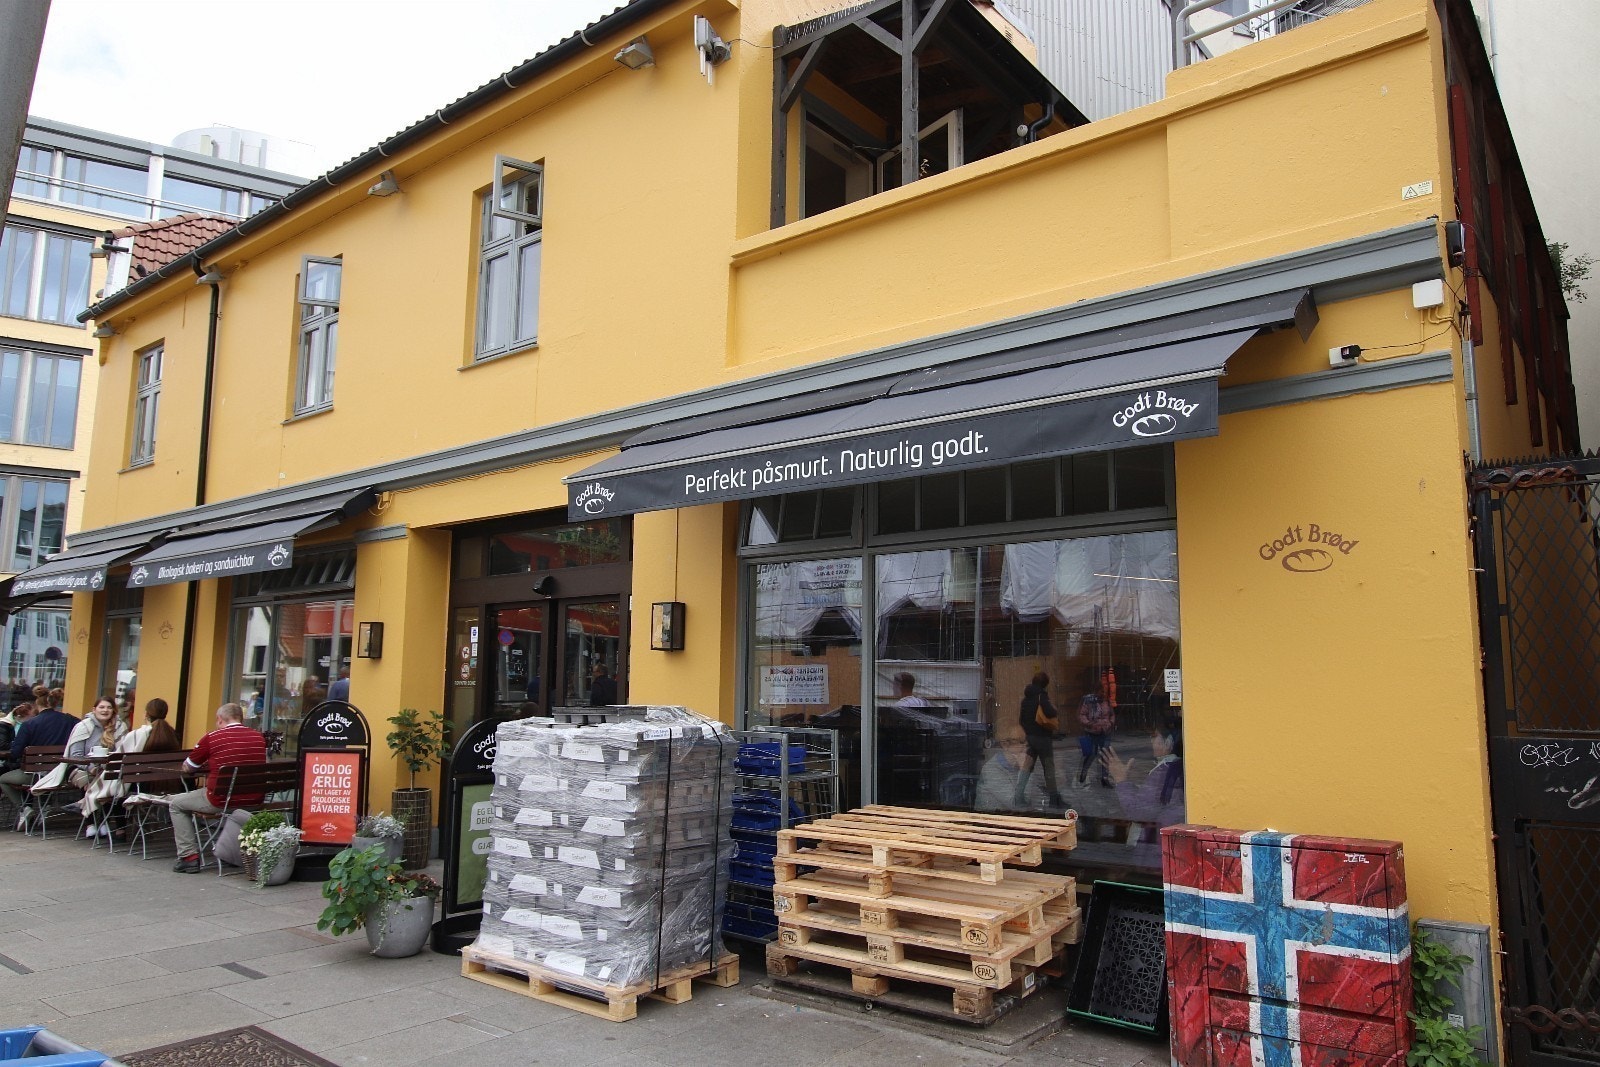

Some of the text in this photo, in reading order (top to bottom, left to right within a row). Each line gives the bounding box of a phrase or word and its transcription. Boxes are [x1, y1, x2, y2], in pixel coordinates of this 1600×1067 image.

[1112, 390, 1200, 428] Godt Brød
[685, 430, 989, 495] Perfekt påsmurt. Naturlig godt.
[575, 482, 615, 507] Godt Brød
[1259, 523, 1360, 560] Godt Brød
[158, 554, 256, 580] Økologisk bakeri og sandwichbar
[317, 712, 352, 728] Godt Brød
[473, 733, 495, 753] Godt
[312, 763, 352, 775] GOD OG
[312, 776, 351, 789] ÆRLIG
[310, 803, 350, 814] RÅVARER
[311, 796, 351, 804] ØKOLOGISKE
[477, 808, 486, 816] EG
